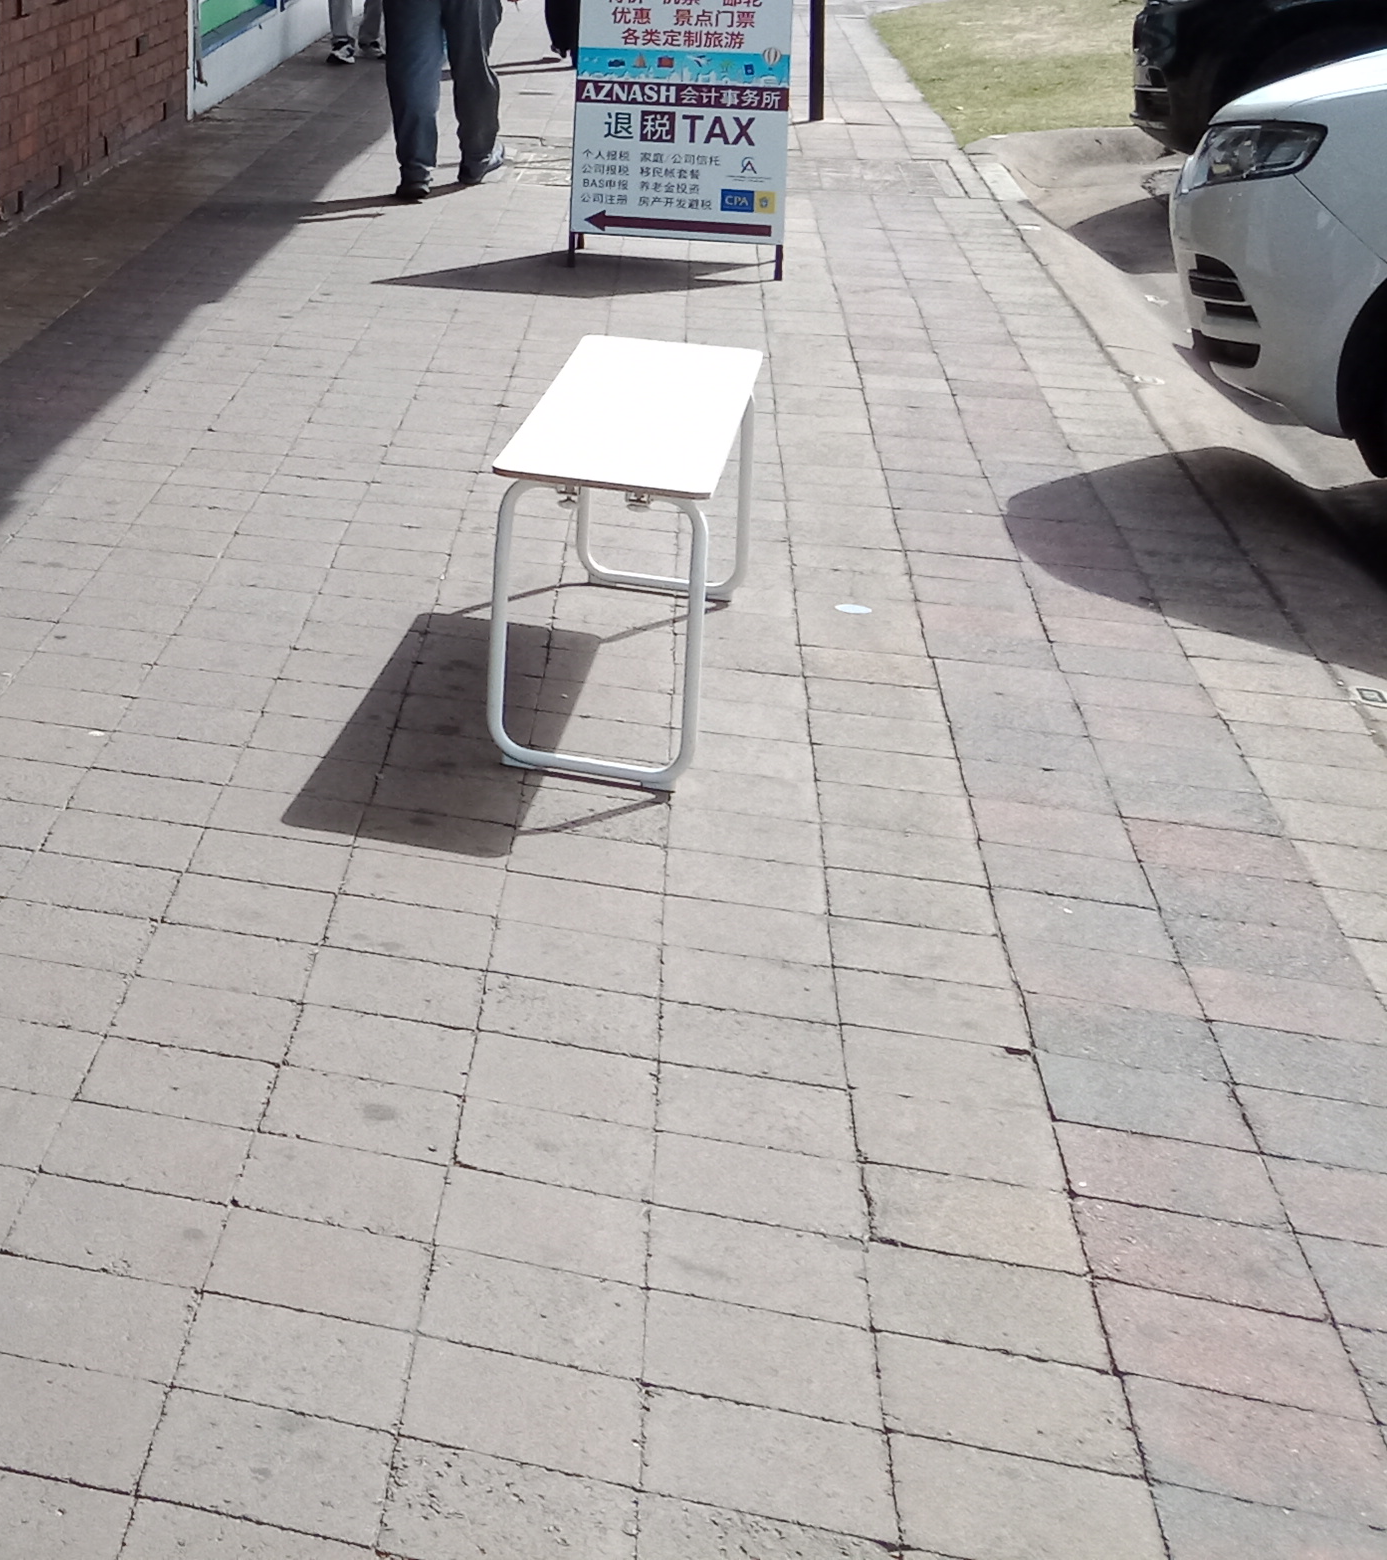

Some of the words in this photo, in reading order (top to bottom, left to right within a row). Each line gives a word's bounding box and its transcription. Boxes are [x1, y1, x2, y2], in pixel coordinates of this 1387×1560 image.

[611, 6, 652, 25] 优惠
[673, 9, 756, 28] 景点门票
[621, 28, 745, 49] 各类定制旅游
[581, 82, 677, 104] AZNASH
[680, 86, 781, 109] 会计事务所
[682, 114, 756, 147] TAX
[582, 149, 630, 162] 个人报税
[581, 163, 630, 177] 公司报税
[724, 195, 750, 207] CPA
